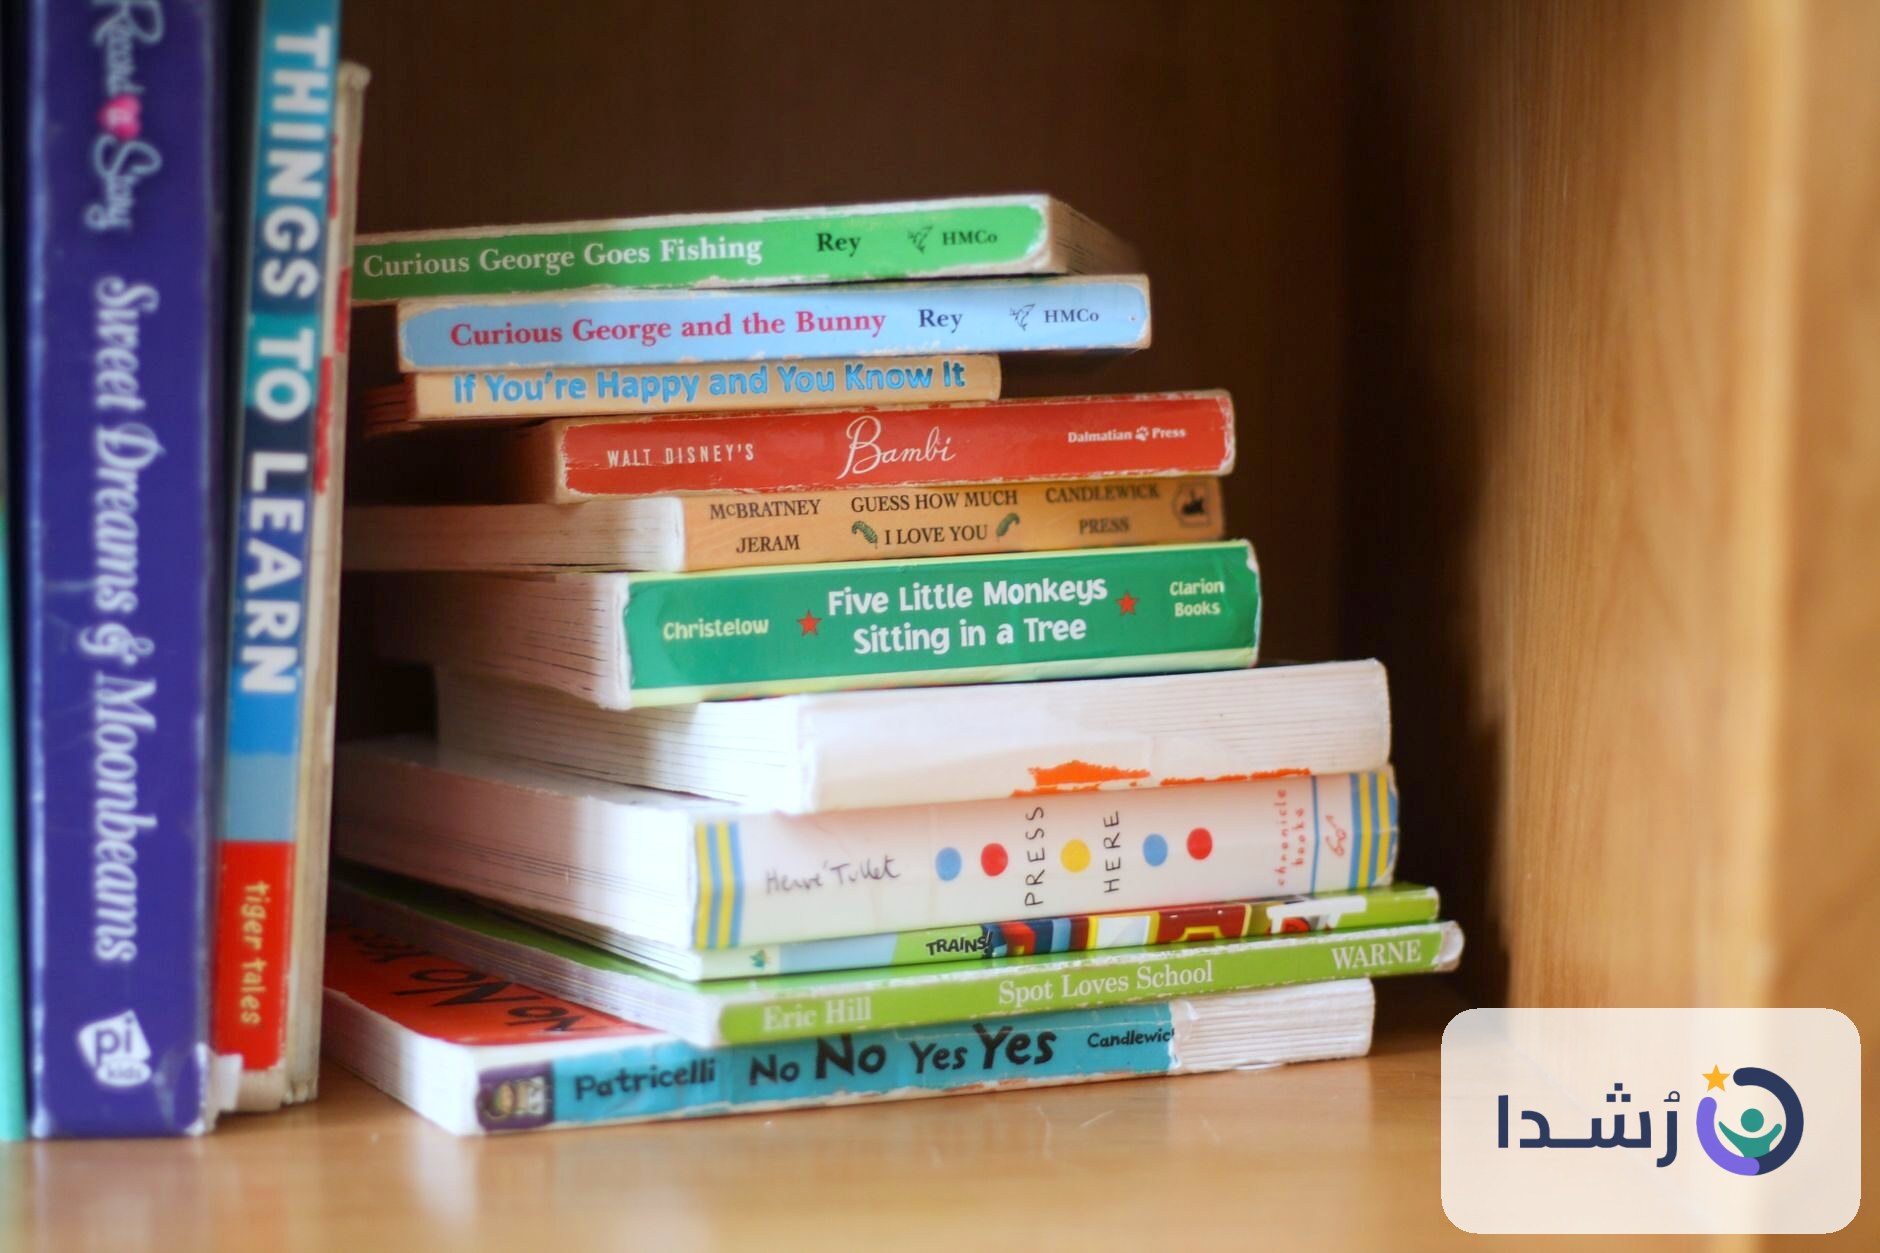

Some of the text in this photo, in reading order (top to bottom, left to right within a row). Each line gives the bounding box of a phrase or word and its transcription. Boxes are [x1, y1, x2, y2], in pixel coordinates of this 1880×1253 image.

[816, 232, 861, 257] Rey
[941, 229, 998, 247] HMCo
[363, 236, 763, 278] Curious George Goes Fishing
[450, 311, 886, 346] Curious George and the Bunny
[918, 308, 963, 333] Rey
[1044, 308, 1100, 324] HMCo
[240, 25, 332, 693] THINGS TO LEARN
[453, 360, 966, 406] If You're Happy and You Know It
[836, 415, 957, 480] Bambi
[1067, 426, 1187, 444] Dalmatian Press
[606, 443, 755, 468] WALT DISNEY'S
[851, 489, 1019, 514] GUESS HOW MUCH
[1045, 482, 1161, 505] CANDLEWICK
[709, 497, 822, 521] McBRATNEY
[884, 523, 988, 547] I LOVE YOU
[1079, 516, 1131, 535] PRESS
[736, 533, 801, 555] JERAM
[827, 576, 1108, 616] Five Little Monkeys
[1169, 579, 1225, 597] Clarion
[79, 275, 166, 963] Sweet Dreams & Moonbeams
[1174, 601, 1221, 618] Books
[662, 617, 770, 641] Christelow
[853, 616, 1087, 655] Sitting in a Tree
[1023, 806, 1120, 907] PRESS HERE
[239, 880, 271, 1026] tiger tales
[925, 931, 994, 956] TRAINS!
[1331, 940, 1422, 970] WARNE
[998, 959, 1214, 1008] Spot Loves School
[762, 996, 872, 1033] Eric Hill
[93, 1016, 135, 1060] pi
[749, 1022, 1058, 1086] No No Yes Yes
[106, 1063, 142, 1081] kids
[574, 1058, 716, 1100] Patricelli
